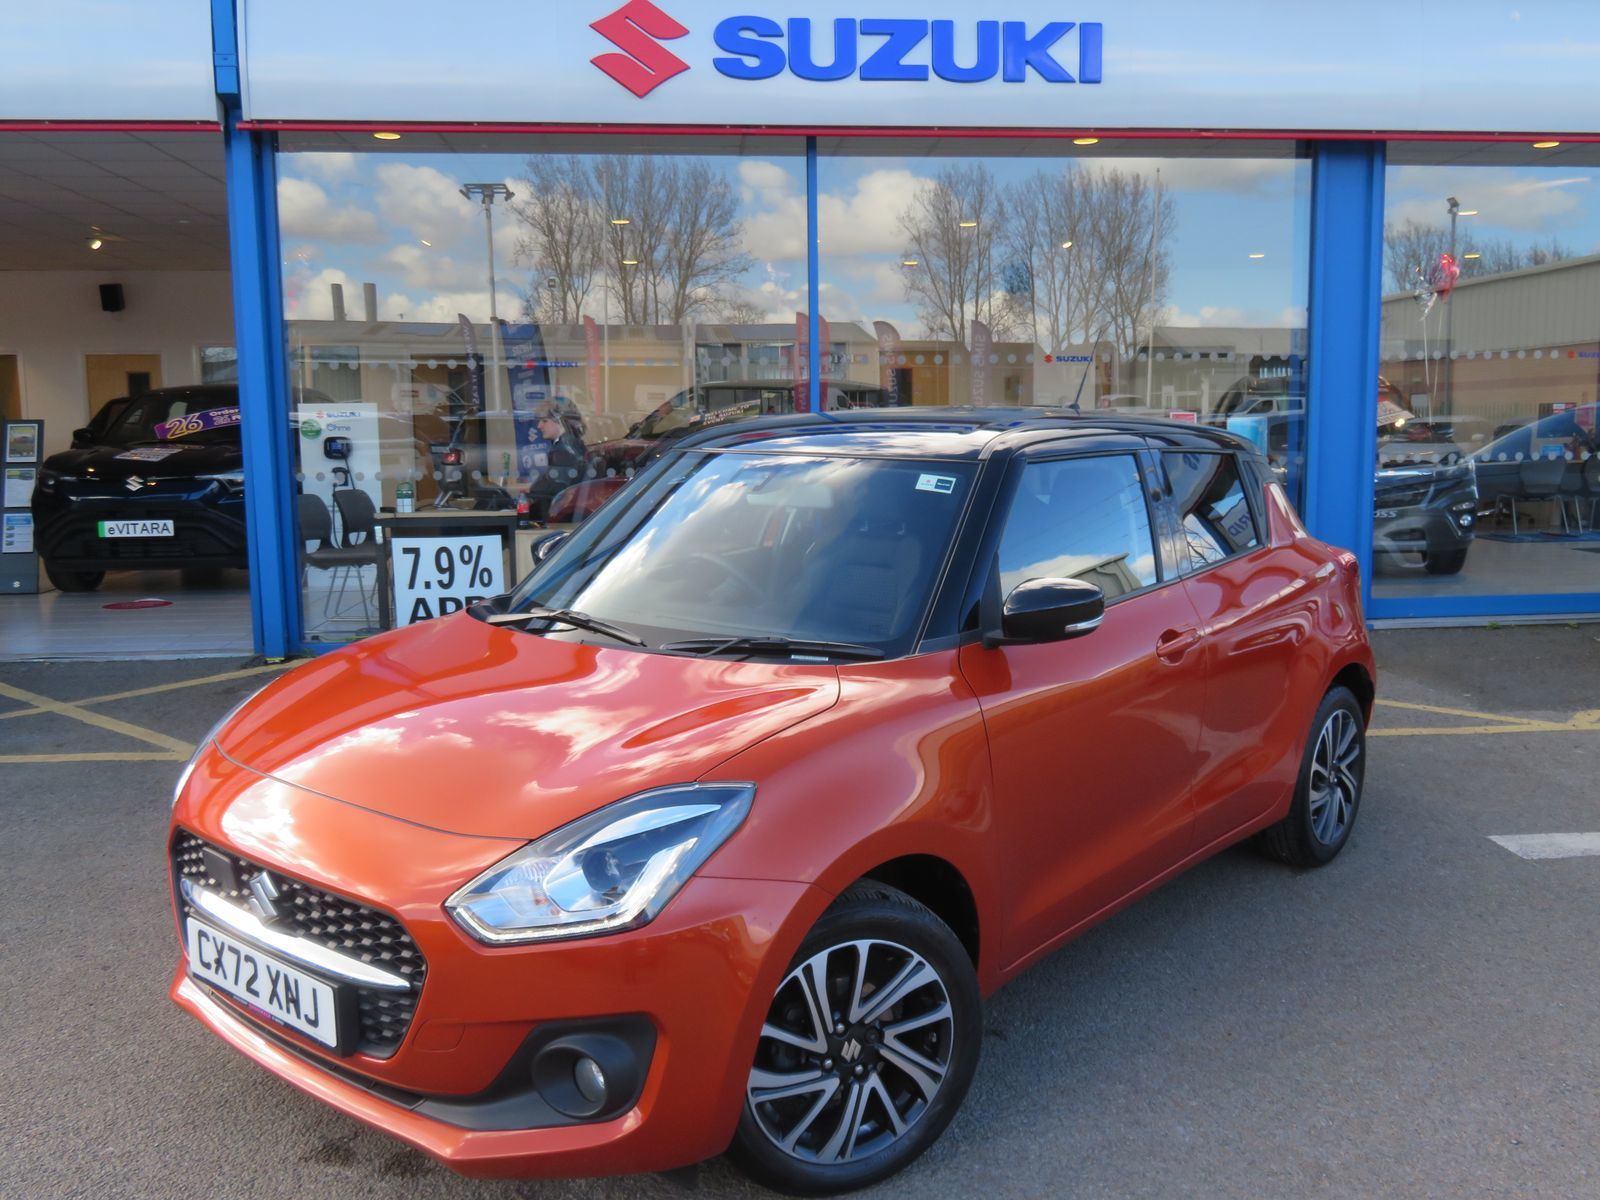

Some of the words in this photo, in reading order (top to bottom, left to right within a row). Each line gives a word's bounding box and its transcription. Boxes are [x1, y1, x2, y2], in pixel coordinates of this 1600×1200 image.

[713, 15, 1102, 84] SUZUKI
[1056, 355, 1093, 363] SUZUKI
[165, 413, 204, 439] 26
[107, 522, 171, 535] eVITARA
[402, 545, 493, 590] 7.9%
[408, 596, 485, 625] AP
[198, 929, 260, 998] CX72
[266, 964, 319, 1029] XNJ
